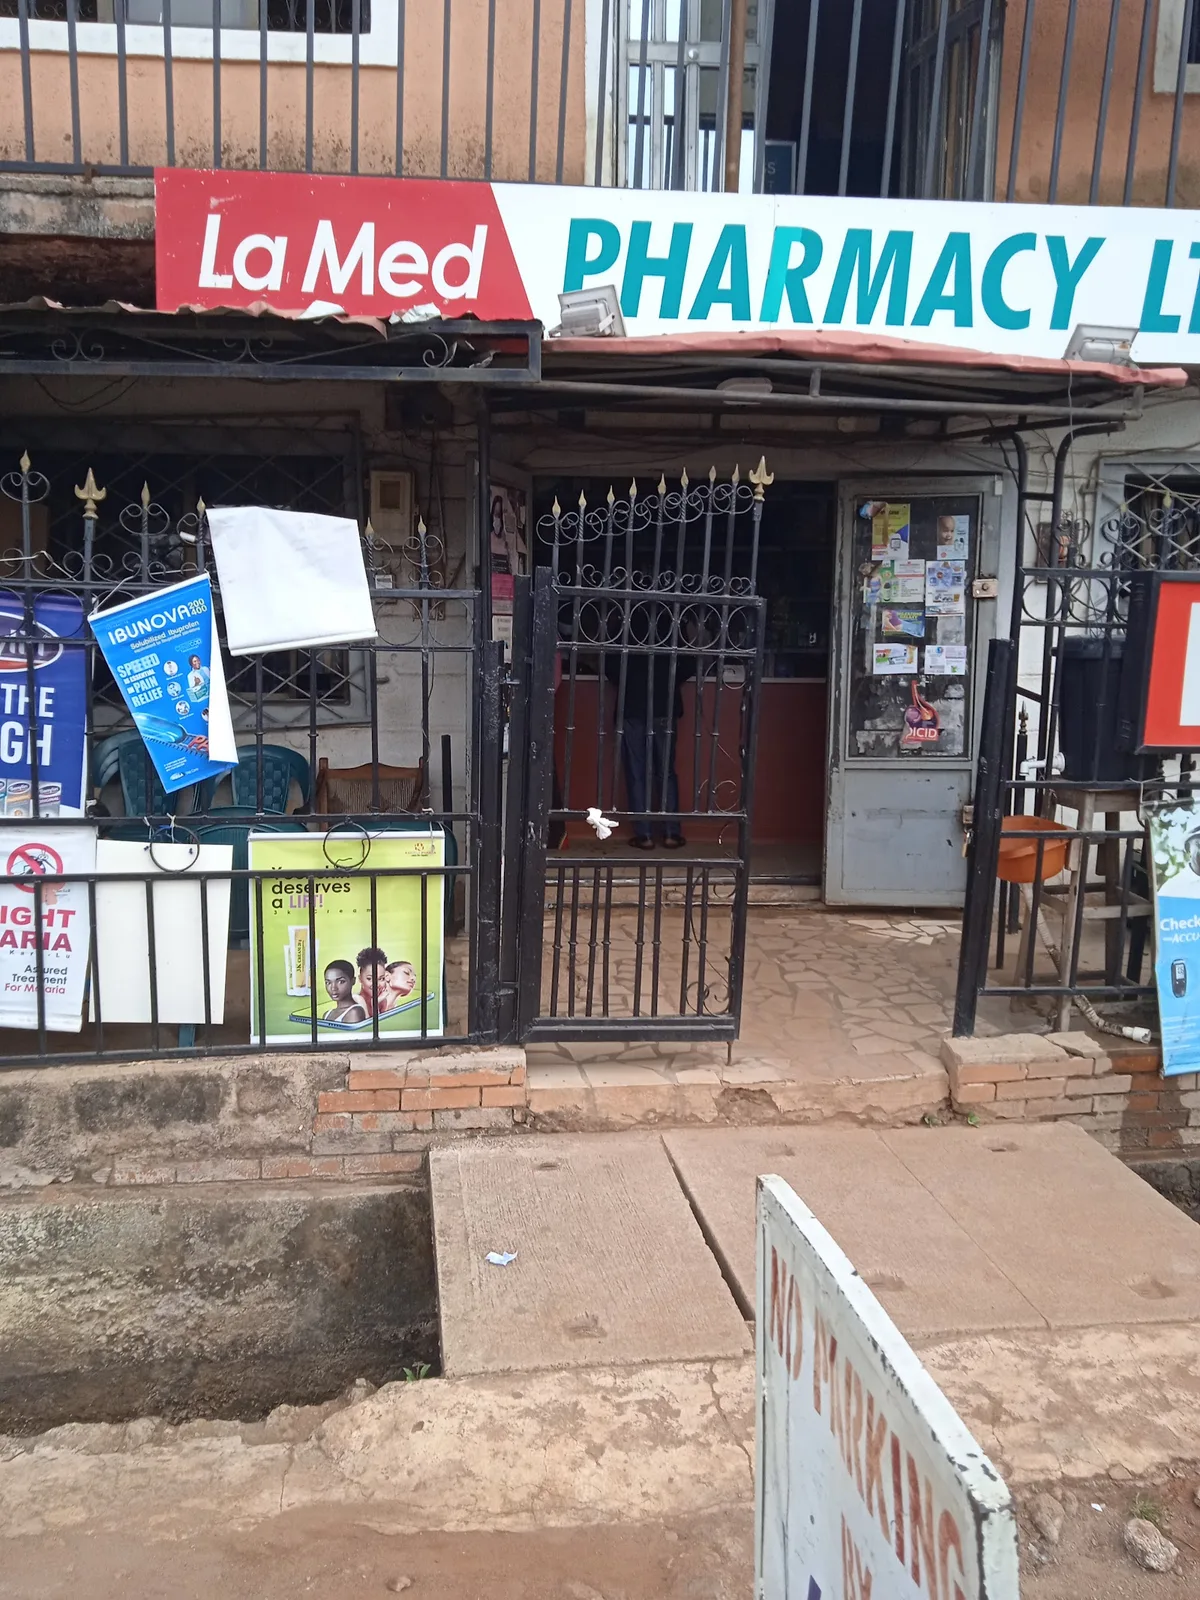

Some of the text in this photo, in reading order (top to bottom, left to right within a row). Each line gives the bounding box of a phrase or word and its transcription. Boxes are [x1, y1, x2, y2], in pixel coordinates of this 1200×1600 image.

[198, 214, 288, 291] La
[301, 219, 488, 300] Med
[562, 218, 1107, 331] PHARMACY
[191, 604, 208, 616] 400
[108, 604, 191, 645] IBUNOVA
[188, 598, 205, 610] 200
[130, 620, 200, 650] Solubilized Ibuprofen
[133, 676, 159, 694] PAIN
[1, 683, 55, 718] THE
[131, 687, 164, 708] RELIEF
[272, 881, 351, 894] deserves
[272, 898, 283, 909] a
[24, 964, 68, 975] Asured
[5, 983, 21, 991] For
[770, 1244, 803, 1382] NO
